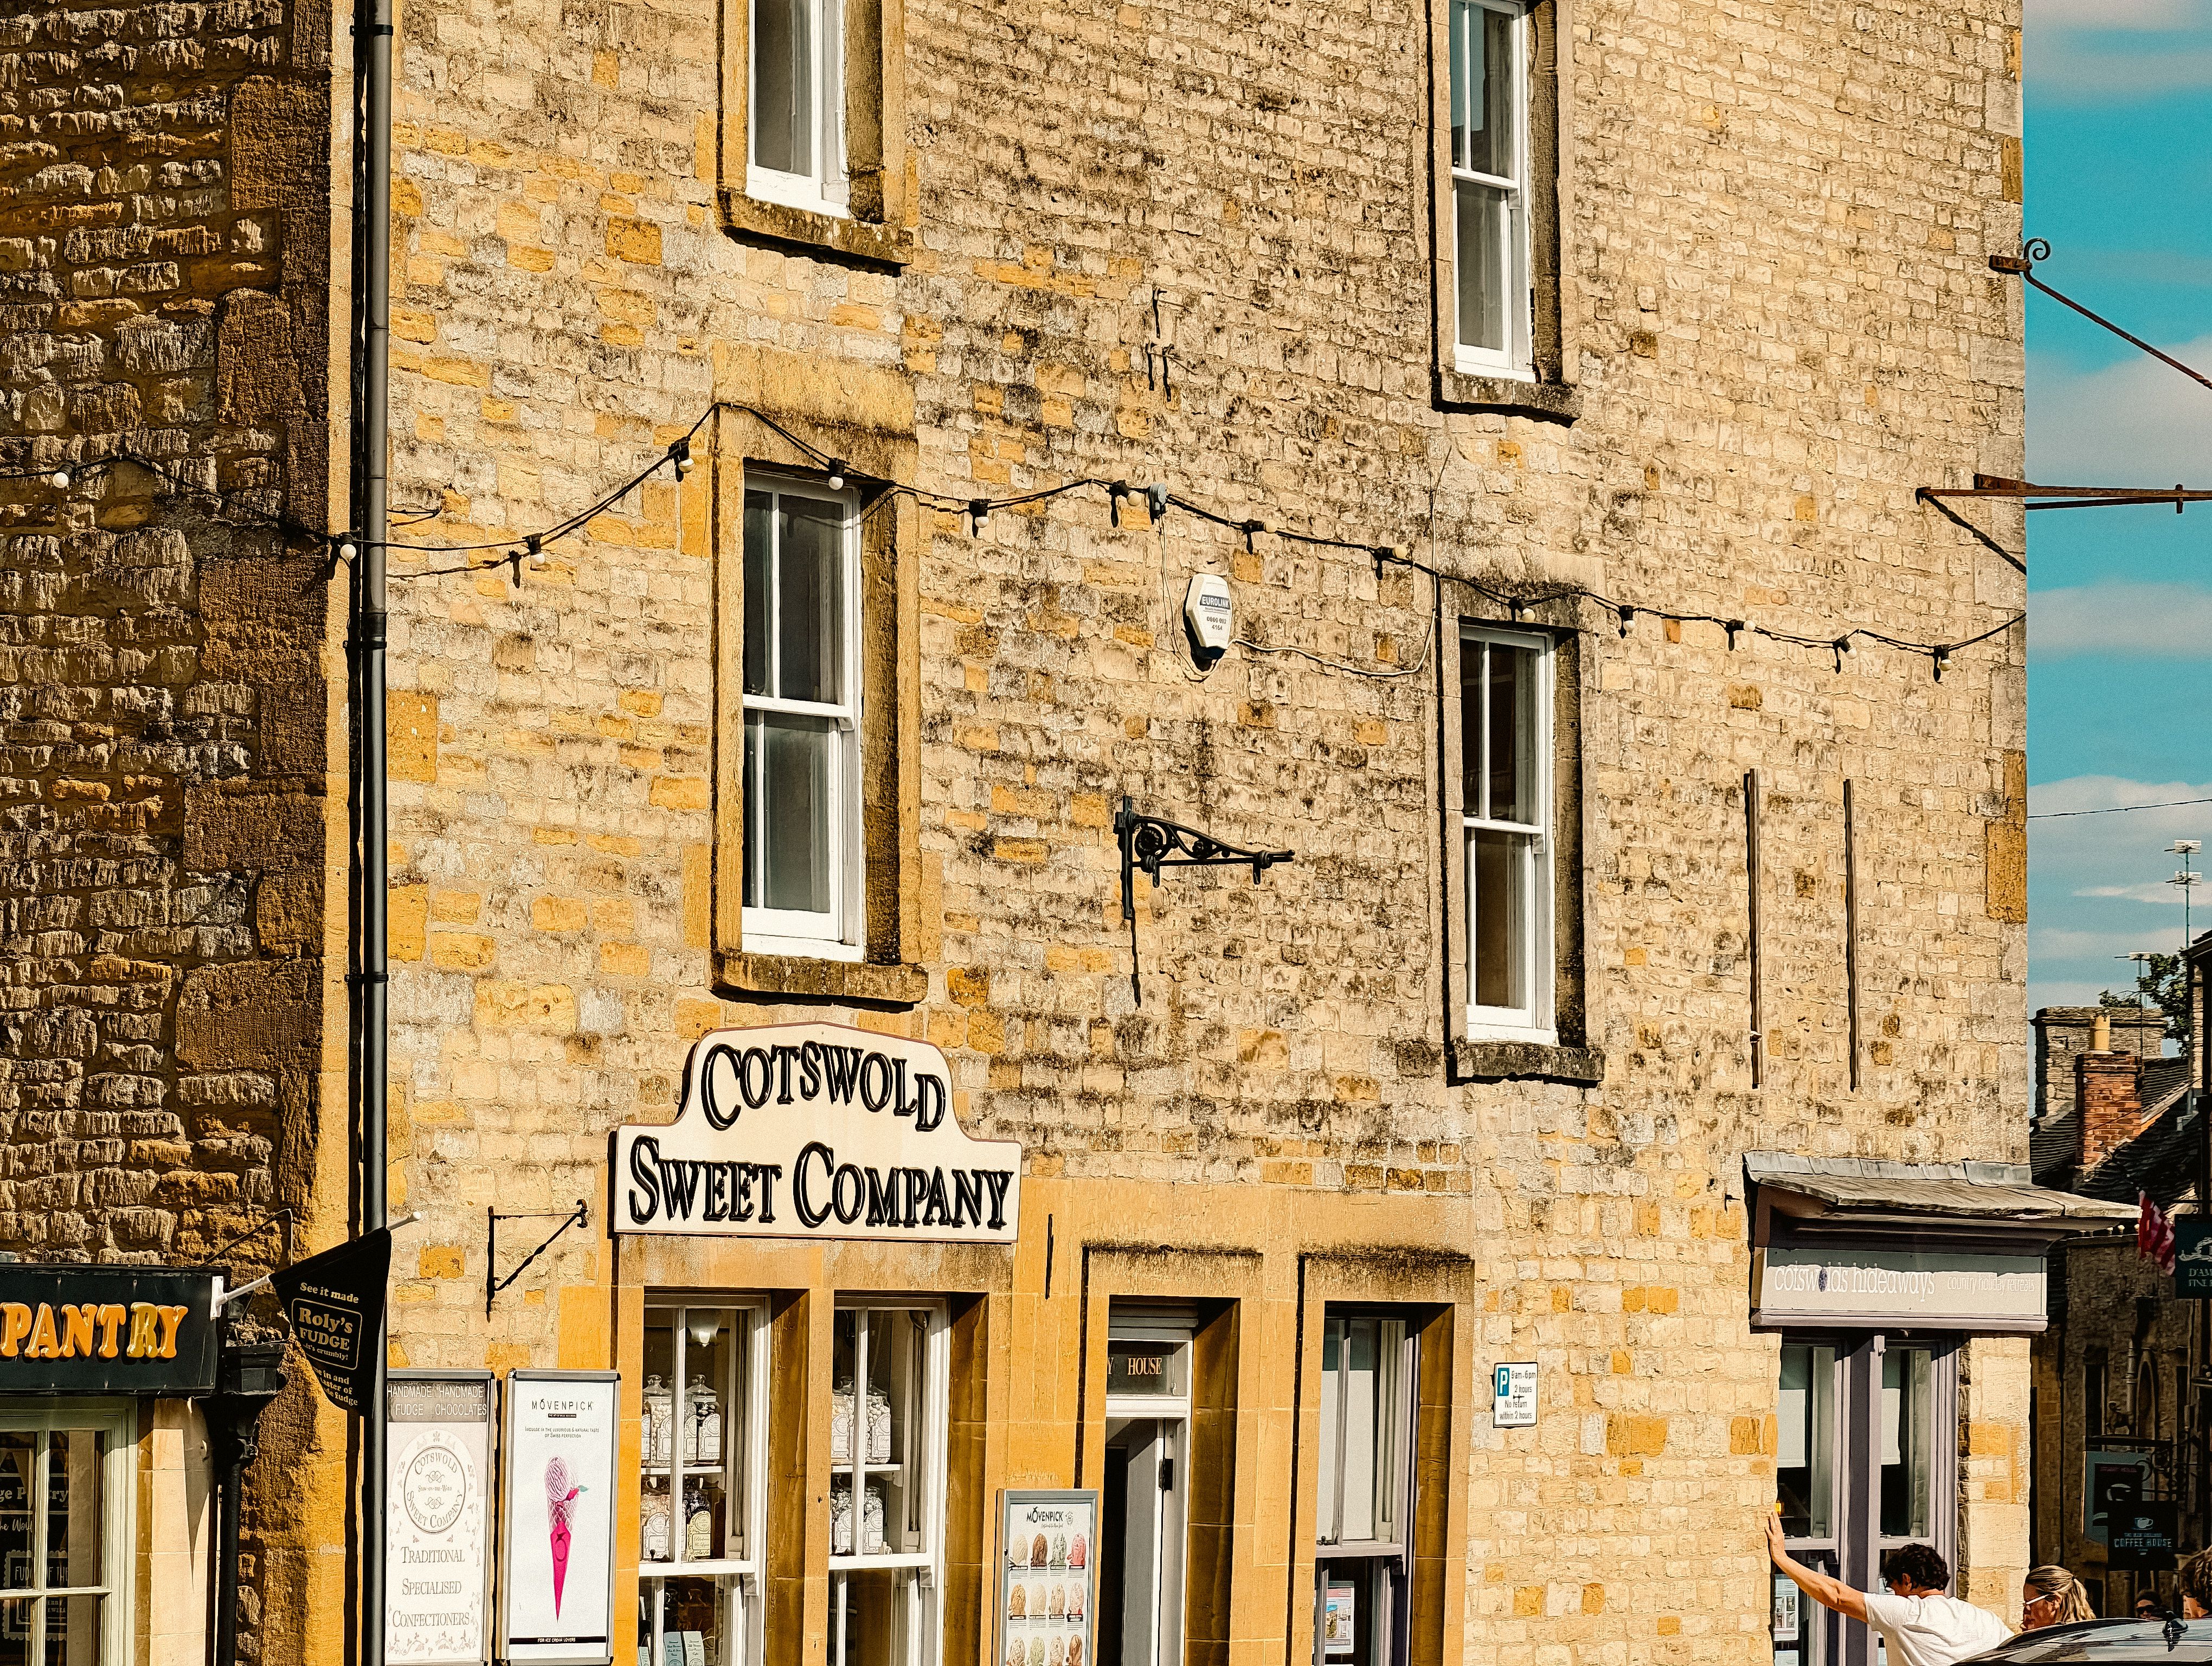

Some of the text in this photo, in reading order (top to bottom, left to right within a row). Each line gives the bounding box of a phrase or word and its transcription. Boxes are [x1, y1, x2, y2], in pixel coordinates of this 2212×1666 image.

[1202, 596, 1229, 608] EUROLINK
[700, 1040, 946, 1132] COTSWOLD
[628, 1134, 1015, 1231] SWEET COMPANY
[1851, 1261, 1935, 1302] hideaways
[1947, 1276, 1977, 1295] country
[1978, 1274, 2005, 1296] holiday
[2007, 1278, 2035, 1292] retreats
[300, 1282, 359, 1303] See it made
[299, 1307, 353, 1334] Roly's
[0, 1302, 189, 1358] PANTRY
[299, 1327, 350, 1351] FUDGE
[317, 1348, 348, 1361] crumbly!
[1128, 1357, 1162, 1375] HOUSE
[323, 1370, 331, 1379] in
[333, 1375, 350, 1385] and
[1500, 1370, 1508, 1394] P
[343, 1387, 353, 1395] of
[387, 1386, 484, 1398] HANDMADE HANDMADE
[1515, 1384, 1532, 1393] 2 hours
[335, 1392, 358, 1406] fudge
[1504, 1399, 1527, 1408] No return
[395, 1403, 487, 1416] FUDGE CHOCOLATES
[1500, 1411, 1532, 1420] within 2 hours
[415, 1452, 458, 1475] COTSWOLD
[407, 1490, 462, 1528] SWEET COMPANY
[2114, 1539, 2143, 1548] COFFEE
[401, 1547, 465, 1563] TRADITIONAL
[402, 1578, 462, 1595] SPECIALISED
[393, 1610, 470, 1627] CONFECTIONERS
